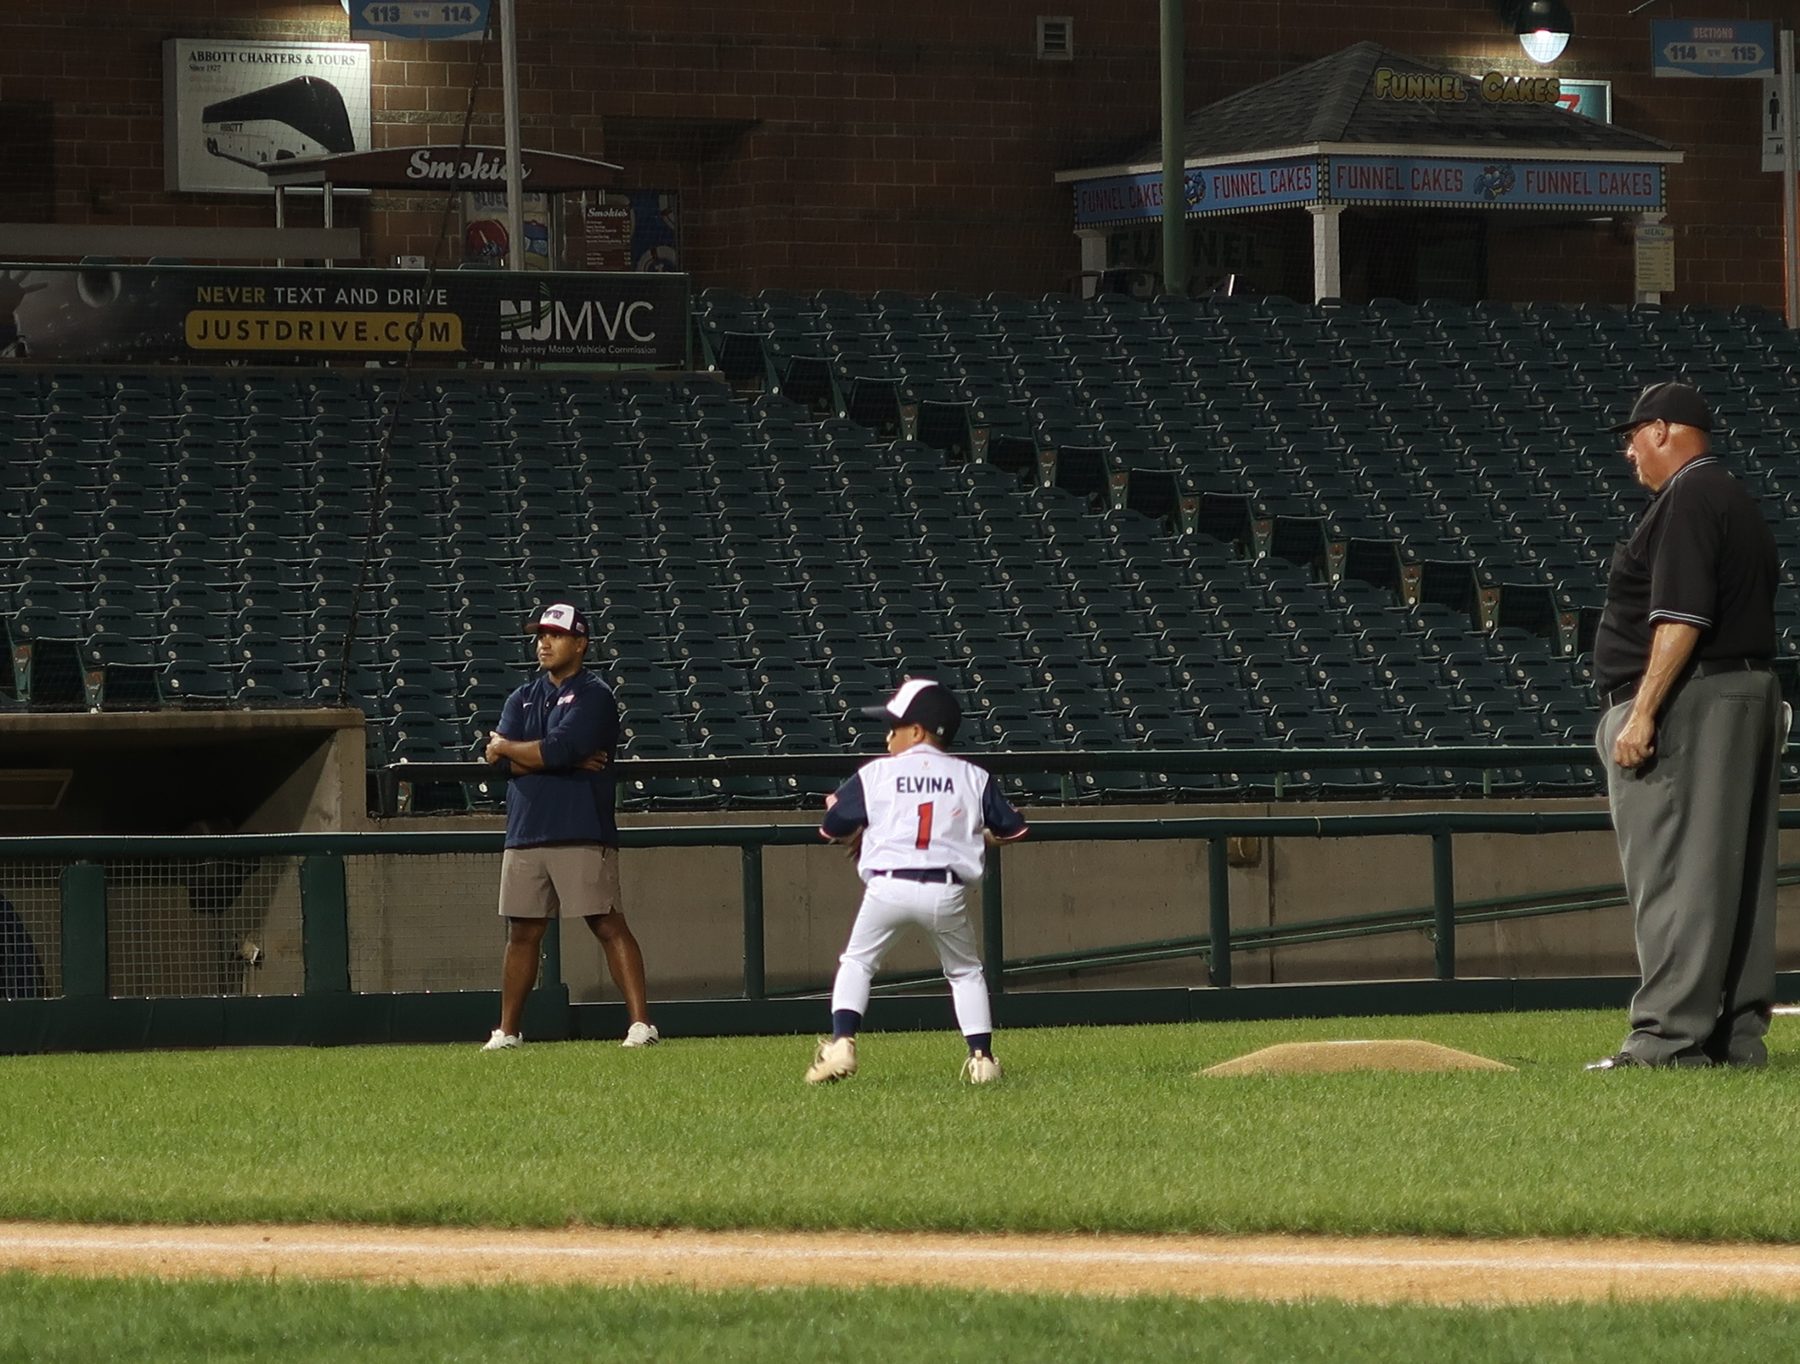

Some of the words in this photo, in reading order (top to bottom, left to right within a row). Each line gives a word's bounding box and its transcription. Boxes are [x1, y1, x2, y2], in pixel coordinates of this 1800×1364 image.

[371, 6, 400, 23] 113
[442, 6, 472, 22] 114
[188, 51, 237, 63] ABBOTT
[239, 52, 302, 64] CHARTERS
[305, 54, 313, 64] &
[316, 54, 356, 66] TOURS
[1670, 45, 1697, 60] 114
[1731, 46, 1757, 61] 115
[1213, 171, 1266, 199] FUNNEL
[1270, 165, 1312, 193] CAKES
[1337, 165, 1405, 191] FUNNEL
[1411, 167, 1463, 192] CAKES
[1526, 169, 1592, 195] FUNNEL
[1599, 171, 1652, 196] CAKES
[1082, 187, 1126, 213] FUNNEL
[1111, 229, 1266, 269] FUNEL
[197, 286, 265, 303] NEVER
[274, 287, 326, 304] TEXT
[335, 288, 379, 305] AND
[388, 288, 448, 306] DRIVE
[197, 319, 451, 343] JUSTDRIVE.COM
[500, 345, 519, 353] New
[521, 345, 546, 355] Jersey
[549, 345, 575, 354] Motor
[576, 345, 607, 354] Vehicle
[608, 346, 657, 355] Commission
[896, 776, 955, 795] ELVINA
[915, 801, 934, 850] 1
